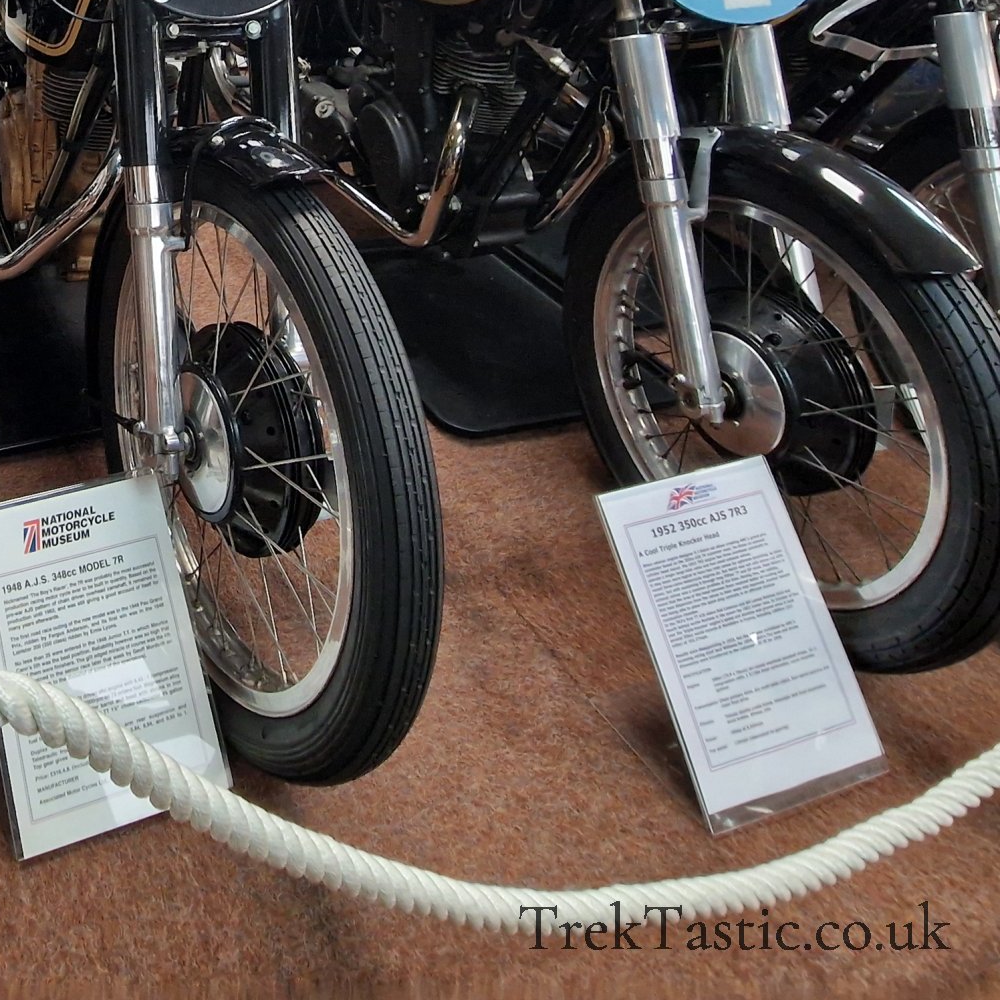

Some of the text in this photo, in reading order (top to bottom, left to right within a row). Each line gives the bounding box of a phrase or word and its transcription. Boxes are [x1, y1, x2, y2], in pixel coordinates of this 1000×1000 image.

[41, 506, 96, 526] NATIONAL
[41, 511, 115, 537] MOTORCYCLE
[651, 505, 748, 538] 1952 350cc AJS 7R3
[42, 529, 90, 549] MUSEUM
[659, 543, 678, 552] Triple
[678, 536, 703, 546] Knocker
[704, 531, 720, 540] Head
[2, 555, 124, 594] 1948 A.J.S. 348cc MODEL 7R
[93, 571, 112, 581] probably
